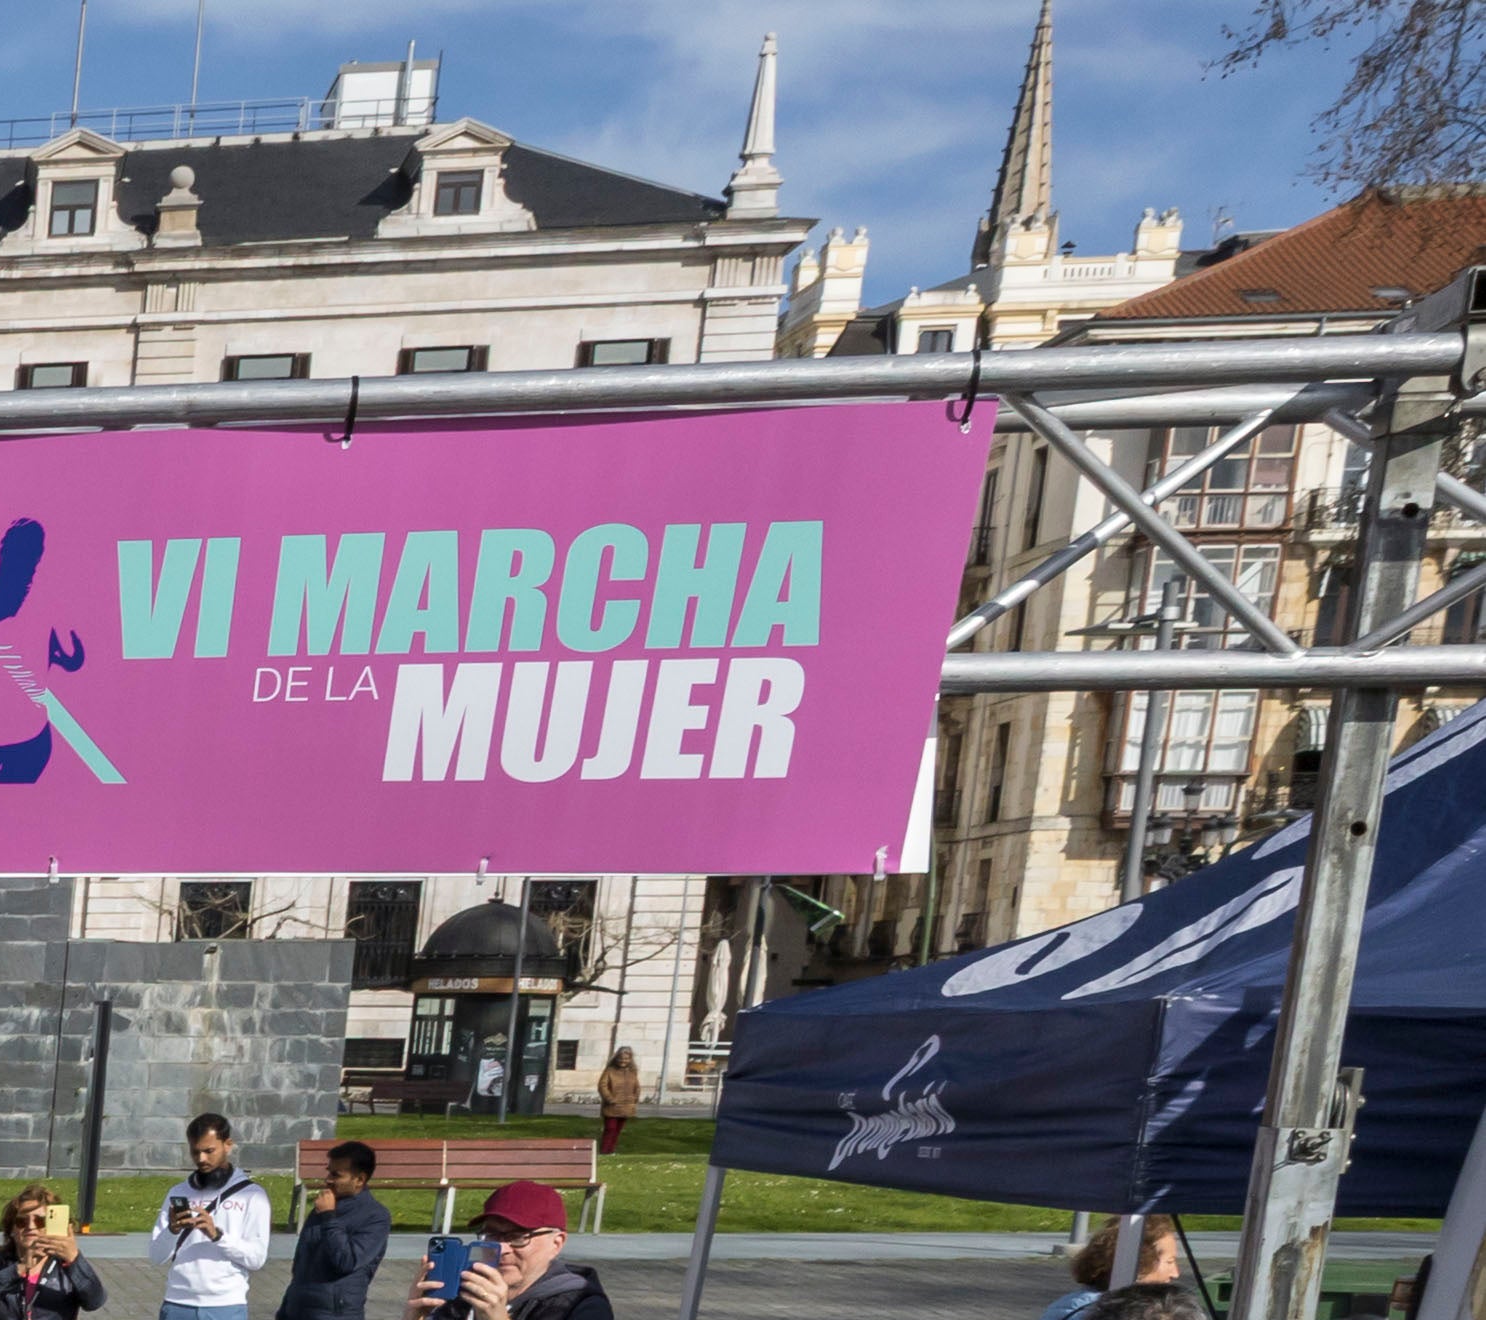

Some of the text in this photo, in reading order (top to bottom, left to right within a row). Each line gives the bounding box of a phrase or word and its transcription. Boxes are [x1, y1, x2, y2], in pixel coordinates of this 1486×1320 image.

[117, 520, 824, 659] VI MARCHA
[253, 665, 379, 702] DE LA
[381, 657, 806, 782] MUJER
[428, 978, 479, 990] HELADOS
